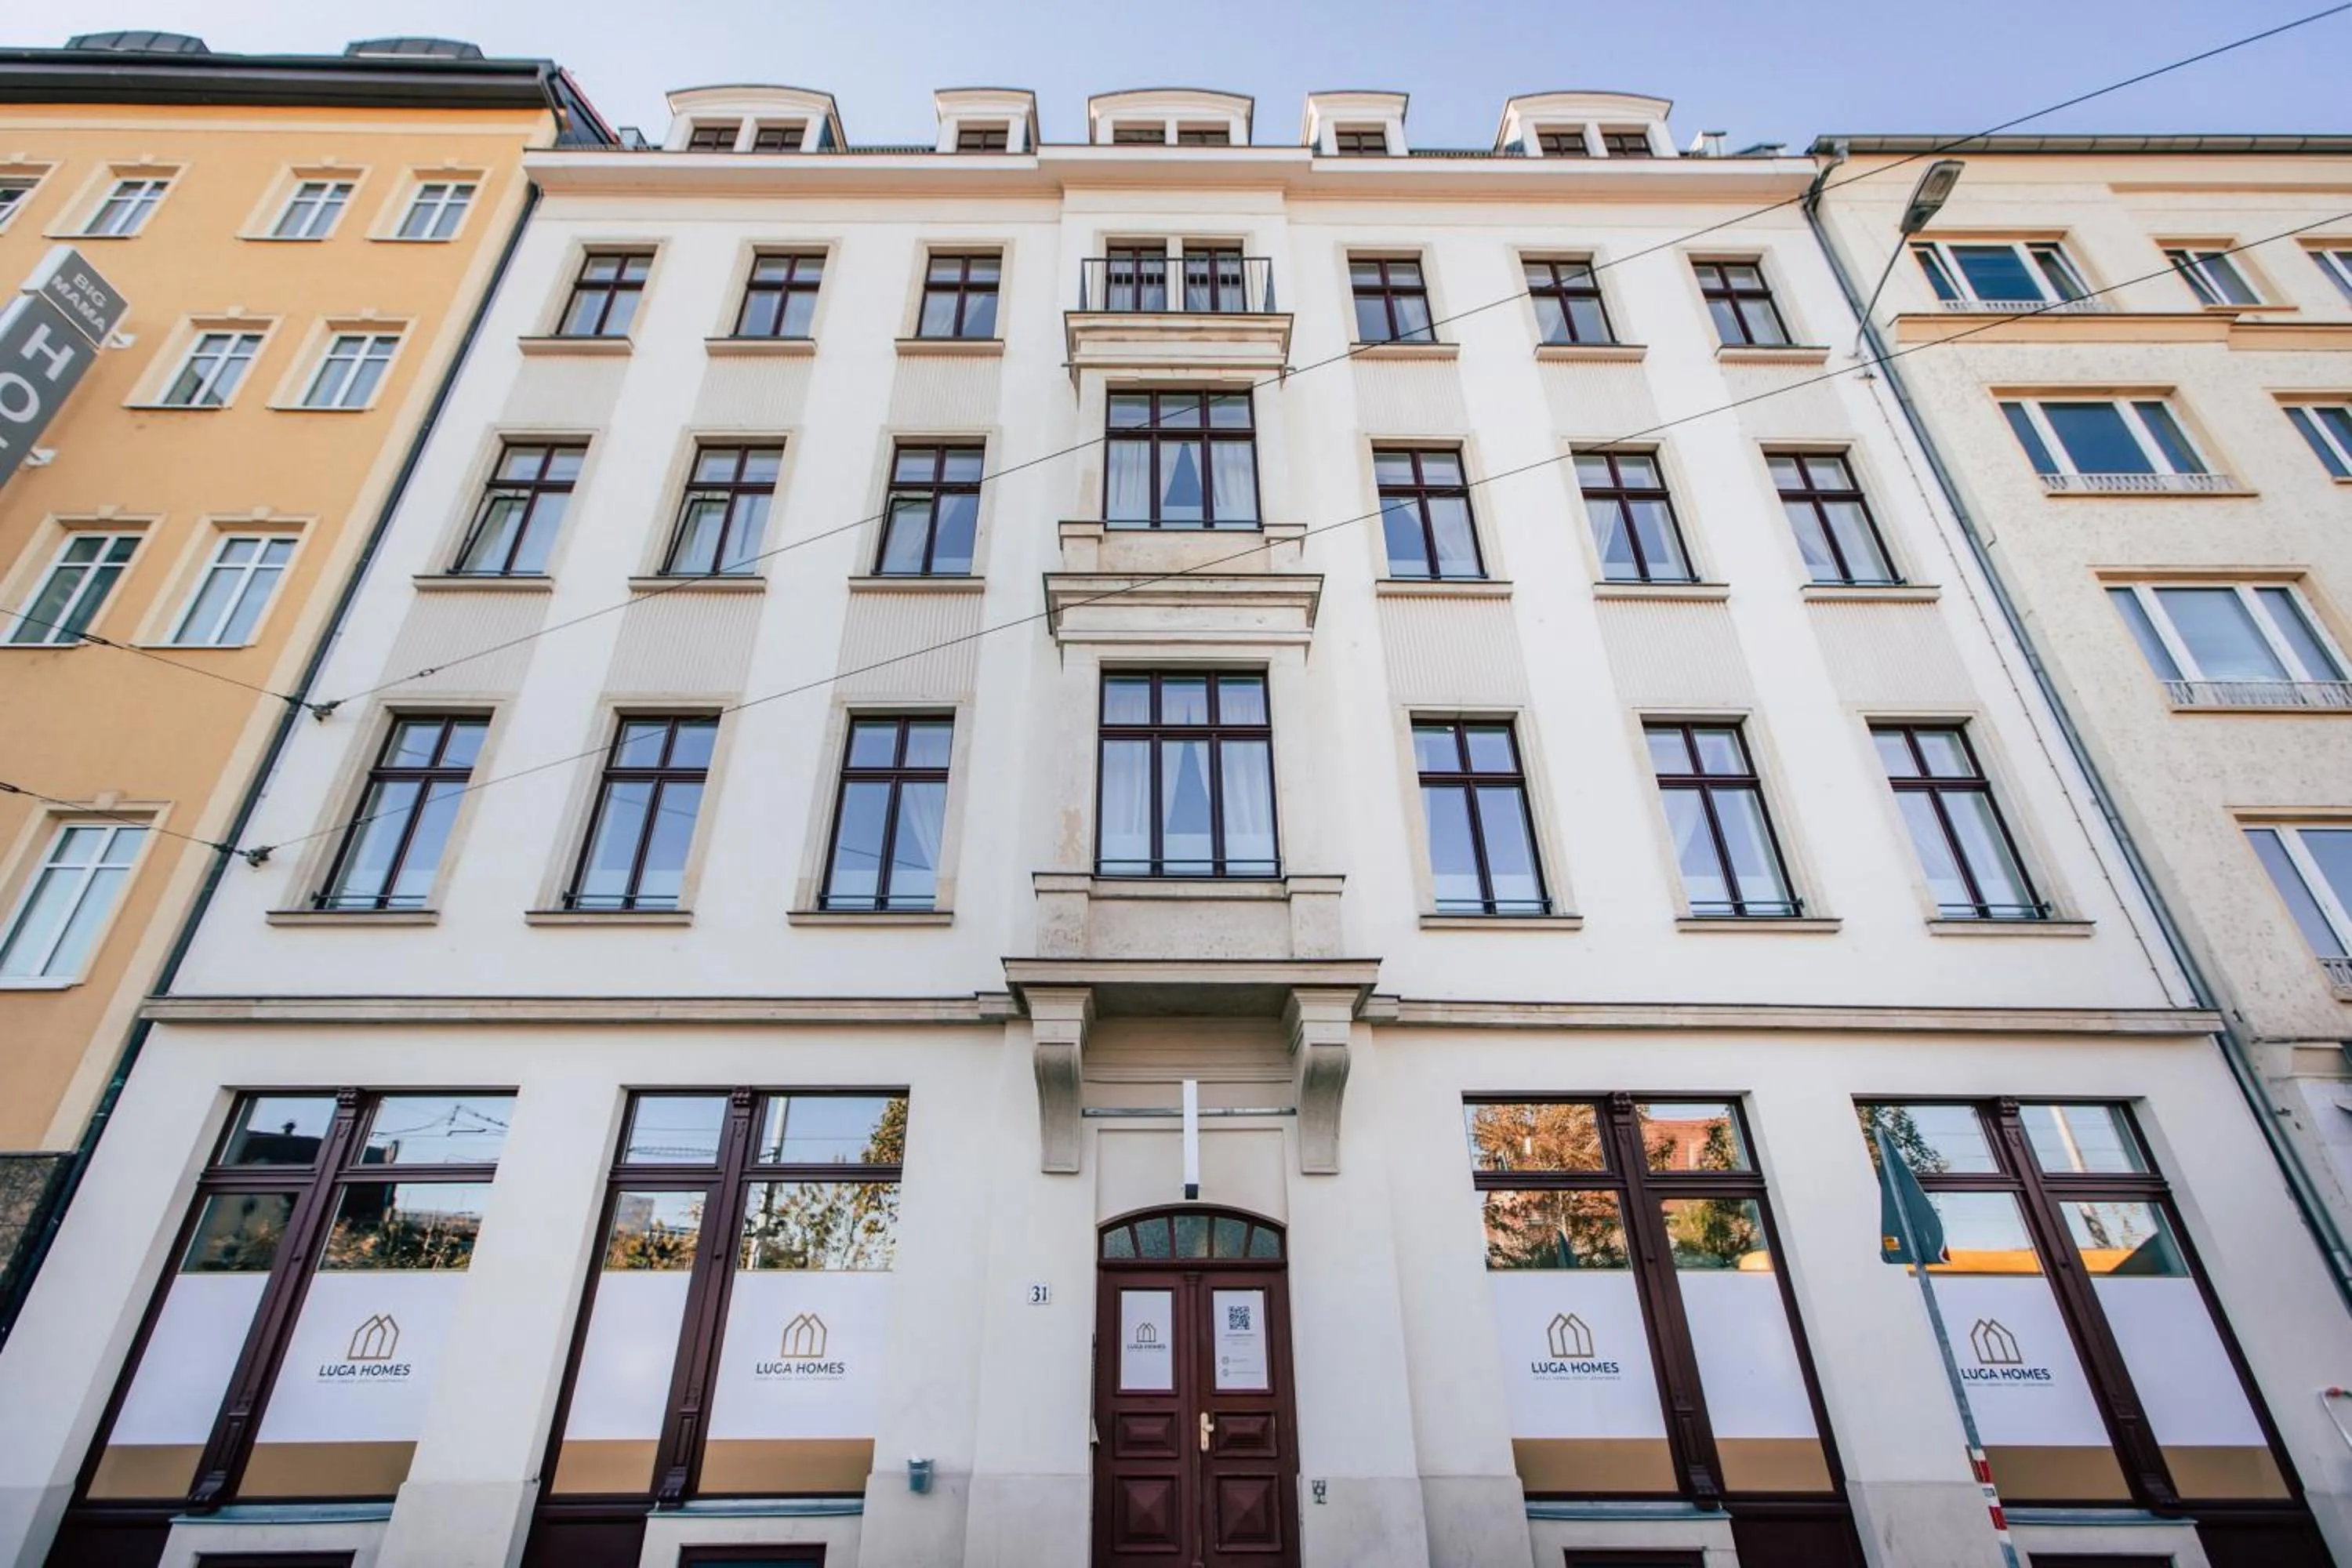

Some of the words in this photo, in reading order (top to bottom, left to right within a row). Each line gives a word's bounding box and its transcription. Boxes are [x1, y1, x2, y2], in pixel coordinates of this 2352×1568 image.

[73, 272, 107, 308] BIG
[51, 274, 106, 333] MAMA
[1032, 1285, 1047, 1302] 31
[319, 1364, 356, 1376] LUGA
[360, 1364, 411, 1376] HOMES
[756, 1363, 792, 1374] LUGA
[796, 1362, 845, 1374] HOMES
[1531, 1362, 1567, 1373] LUGA
[1570, 1362, 1619, 1373] HOMES
[1962, 1369, 1998, 1379] LUGA
[2000, 1369, 2051, 1380] HOMES
